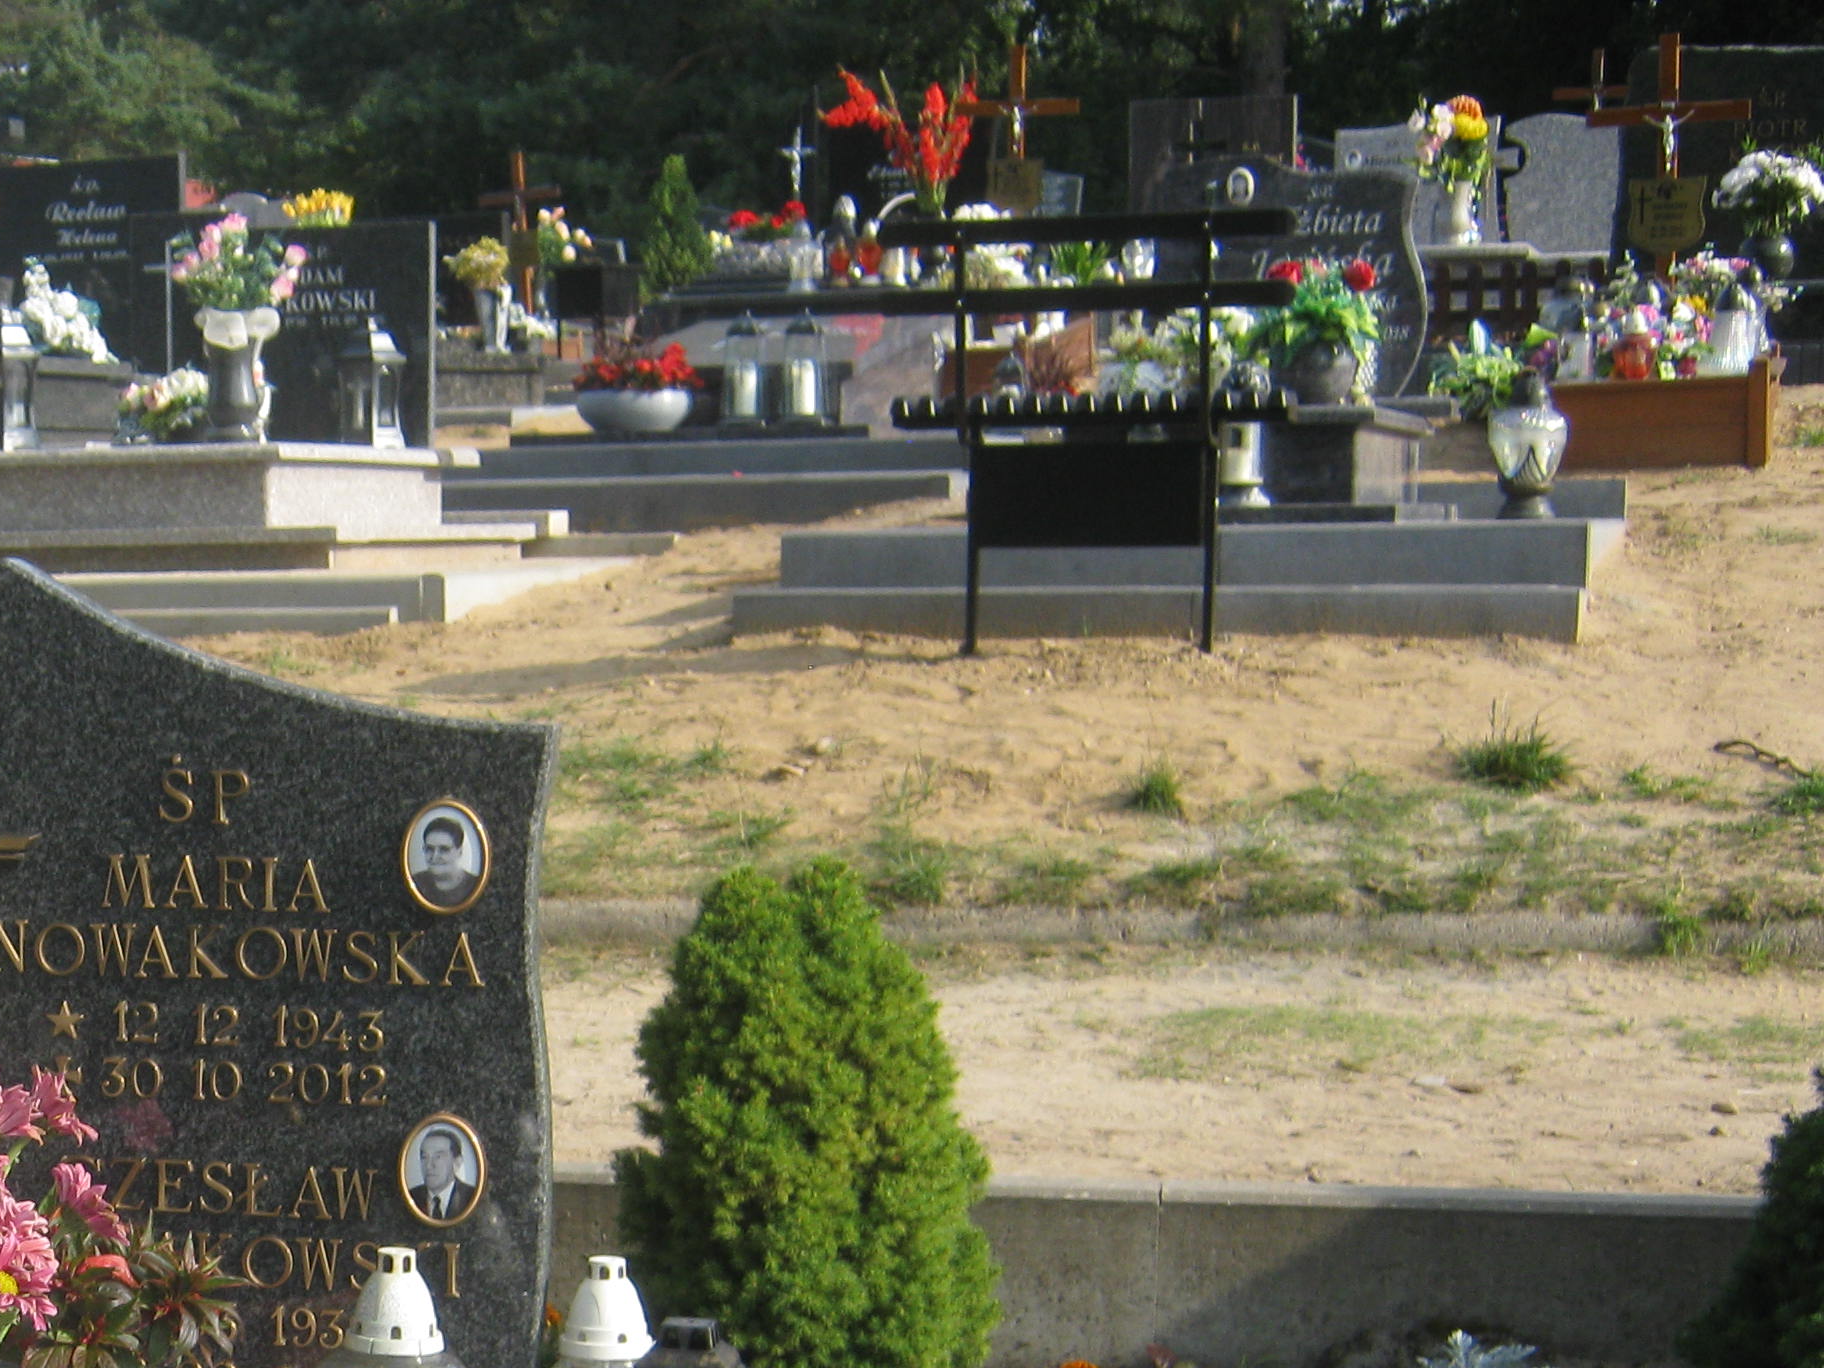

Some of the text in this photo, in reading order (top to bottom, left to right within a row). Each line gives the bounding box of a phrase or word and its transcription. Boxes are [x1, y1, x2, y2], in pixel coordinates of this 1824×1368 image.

[300, 266, 344, 286] DAM
[103, 853, 331, 913] MARIA
[112, 1000, 385, 1053] 12 12 1943
[101, 1056, 387, 1106] 30 10 2012
[270, 1304, 345, 1350] 193
